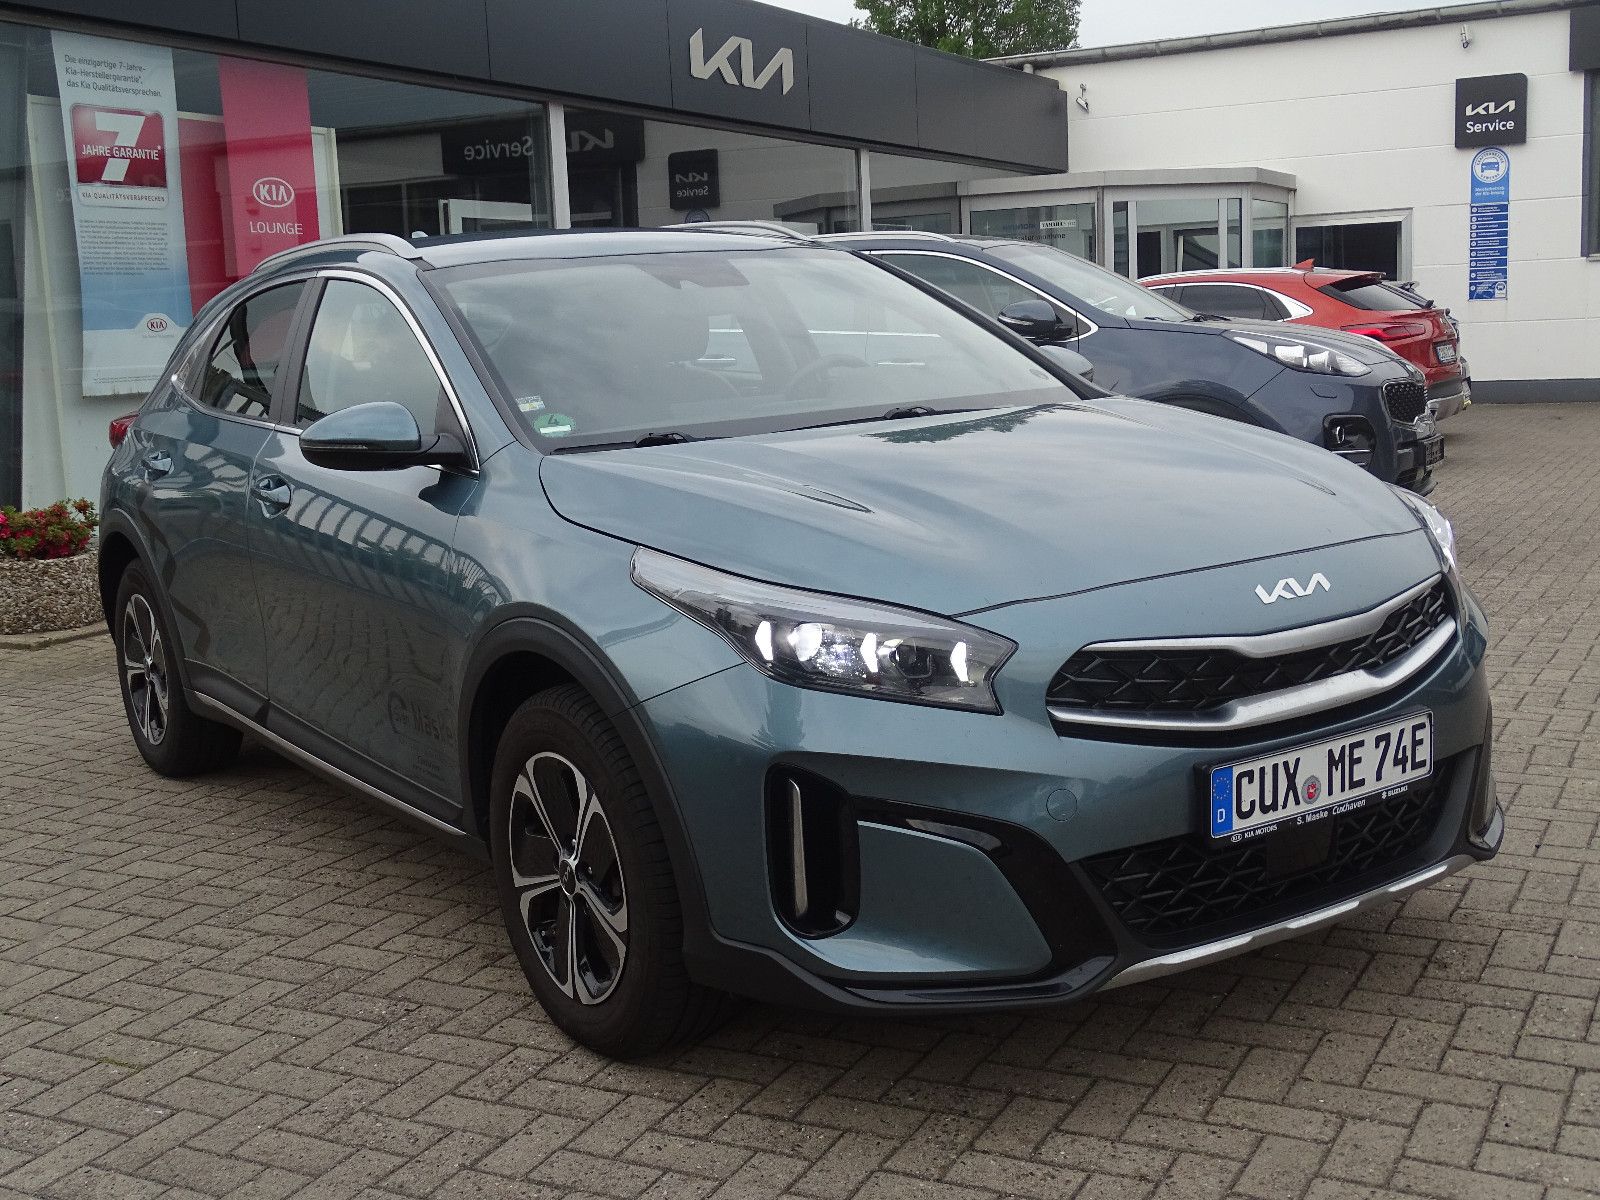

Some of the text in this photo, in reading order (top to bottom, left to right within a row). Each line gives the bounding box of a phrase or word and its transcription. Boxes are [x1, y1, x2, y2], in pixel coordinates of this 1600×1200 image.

[64, 54, 77, 64] Die
[78, 57, 117, 70] einzigartige
[689, 27, 794, 95] KIA
[66, 80, 79, 88] das
[80, 81, 91, 89] Kia
[1465, 99, 1516, 117] KIA
[1466, 119, 1515, 133] Service
[82, 144, 111, 157] JAHRE
[94, 111, 146, 182] 7
[259, 184, 290, 202] KIA
[250, 221, 304, 235] LOUNGE
[149, 320, 165, 331] KIA
[1255, 573, 1331, 604] KIA
[1235, 722, 1427, 820] CUX ME 74E
[1217, 808, 1226, 823] D
[1296, 816, 1304, 825] S.
[1306, 809, 1329, 823] Maske
